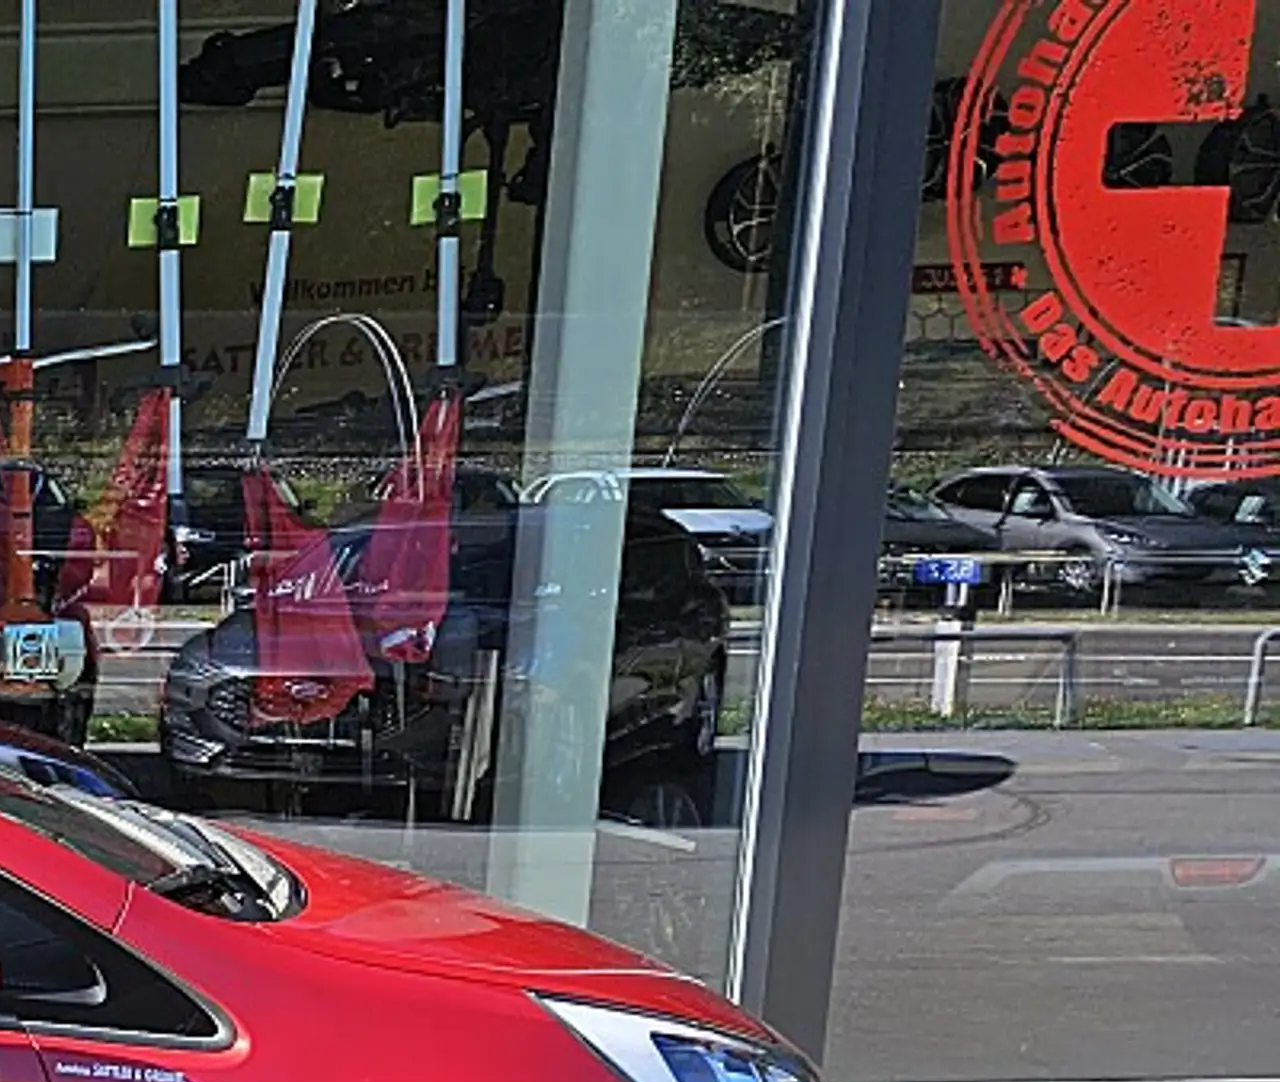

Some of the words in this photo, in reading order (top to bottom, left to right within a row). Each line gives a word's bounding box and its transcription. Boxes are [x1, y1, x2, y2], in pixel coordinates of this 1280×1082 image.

[991, 0, 1096, 245] Autoha
[249, 274, 416, 304] Wllkommen
[1019, 290, 1100, 383] Das
